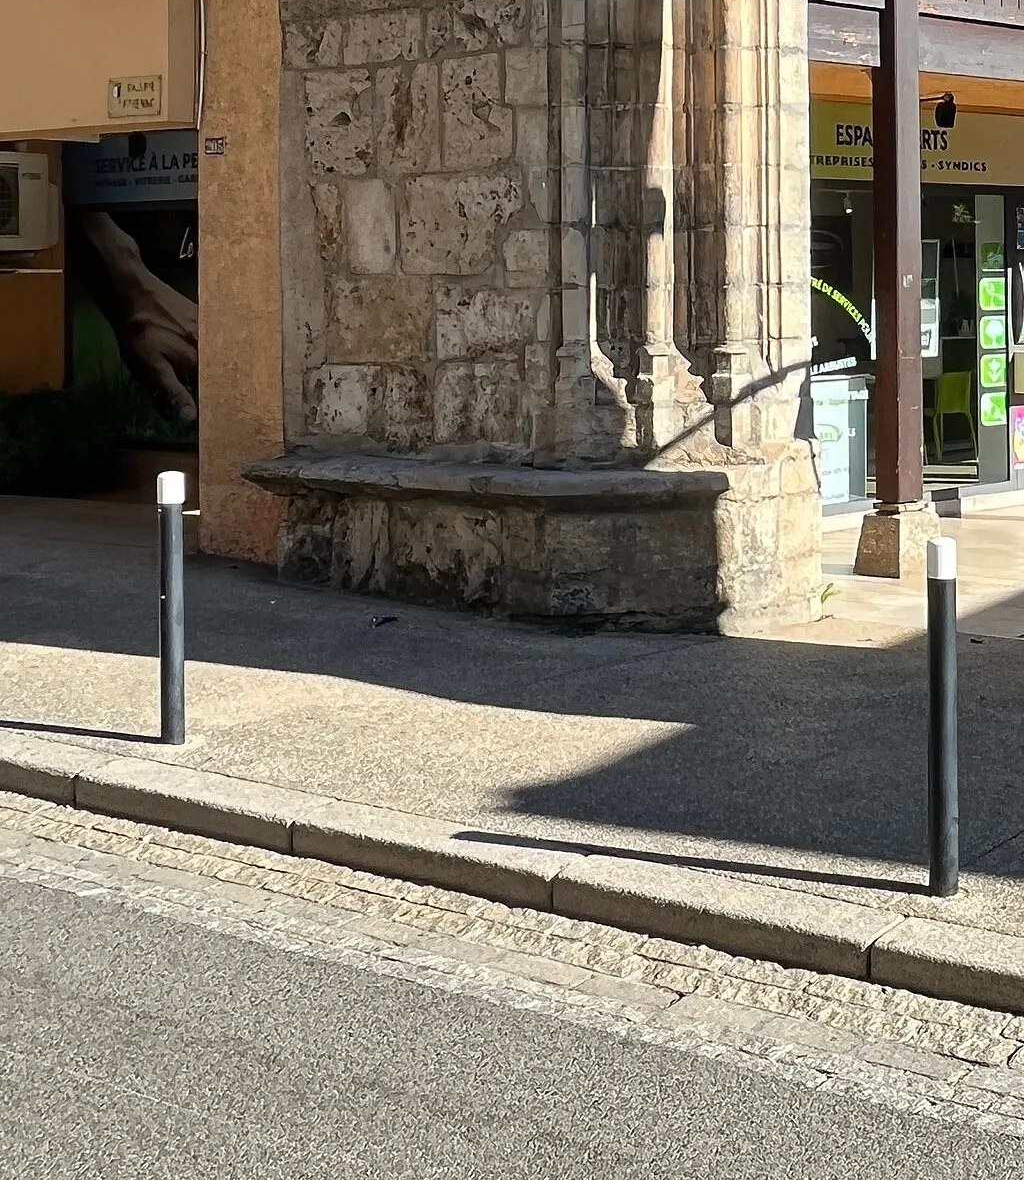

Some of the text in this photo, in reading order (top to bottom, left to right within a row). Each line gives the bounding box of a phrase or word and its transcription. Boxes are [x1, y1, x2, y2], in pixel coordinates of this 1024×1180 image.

[919, 129, 948, 151] RTS
[95, 155, 145, 174] SERVICE
[149, 151, 159, 171] À
[162, 153, 180, 169] LA
[938, 159, 987, 172] SYNDICS
